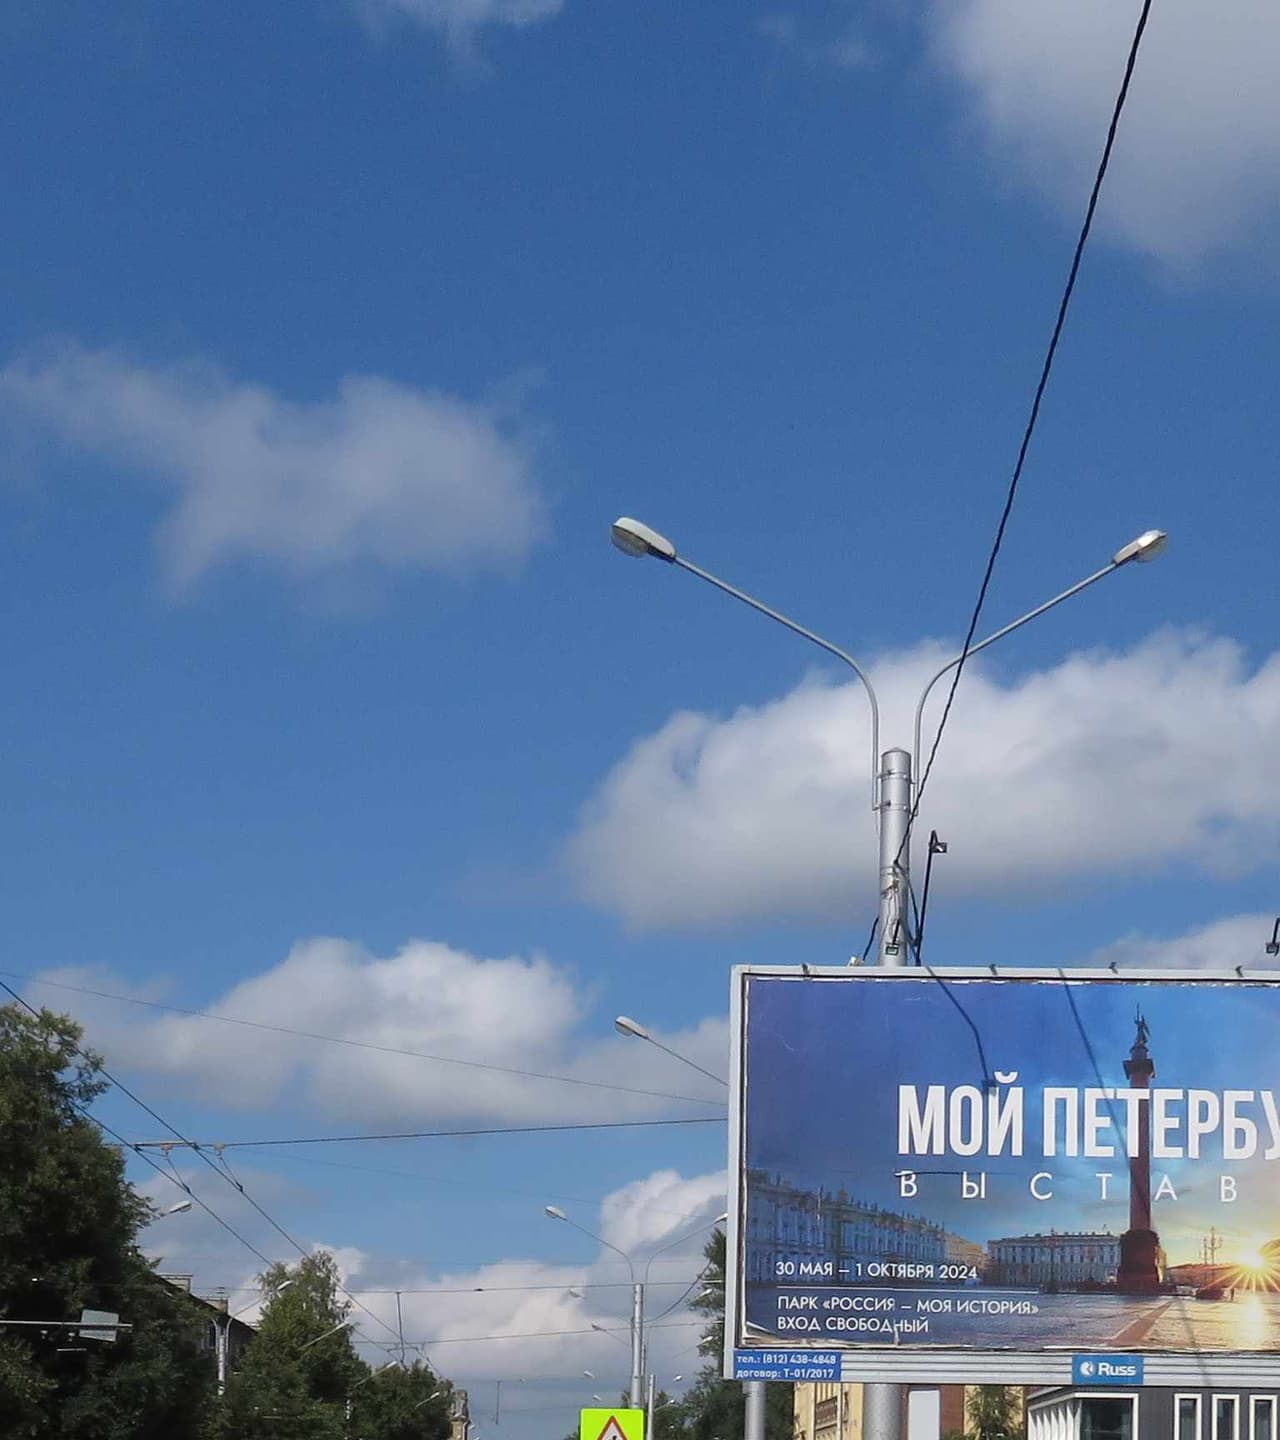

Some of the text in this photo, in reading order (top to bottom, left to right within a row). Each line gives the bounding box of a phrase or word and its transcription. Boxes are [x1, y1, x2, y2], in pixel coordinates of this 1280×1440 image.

[898, 1071, 1024, 1157] МОЙ
[775, 1261, 795, 1276] 30
[799, 1262, 833, 1277] МАЯ
[855, 1263, 862, 1277] 1
[867, 1262, 934, 1279] ОКТЯБРЯ
[939, 1264, 978, 1280] 2024
[777, 1296, 819, 1311] ПАРК
[823, 1296, 896, 1312] «РОССИЯ
[916, 1299, 952, 1313] МОЯ
[956, 1300, 1040, 1315] ИСТОРИЯ»
[777, 1315, 930, 1333] ВХОД СВОБОДНЫЙ
[762, 1352, 788, 1365] (812)
[735, 1368, 781, 1379] договор:
[1097, 1361, 1137, 1377] Russ
